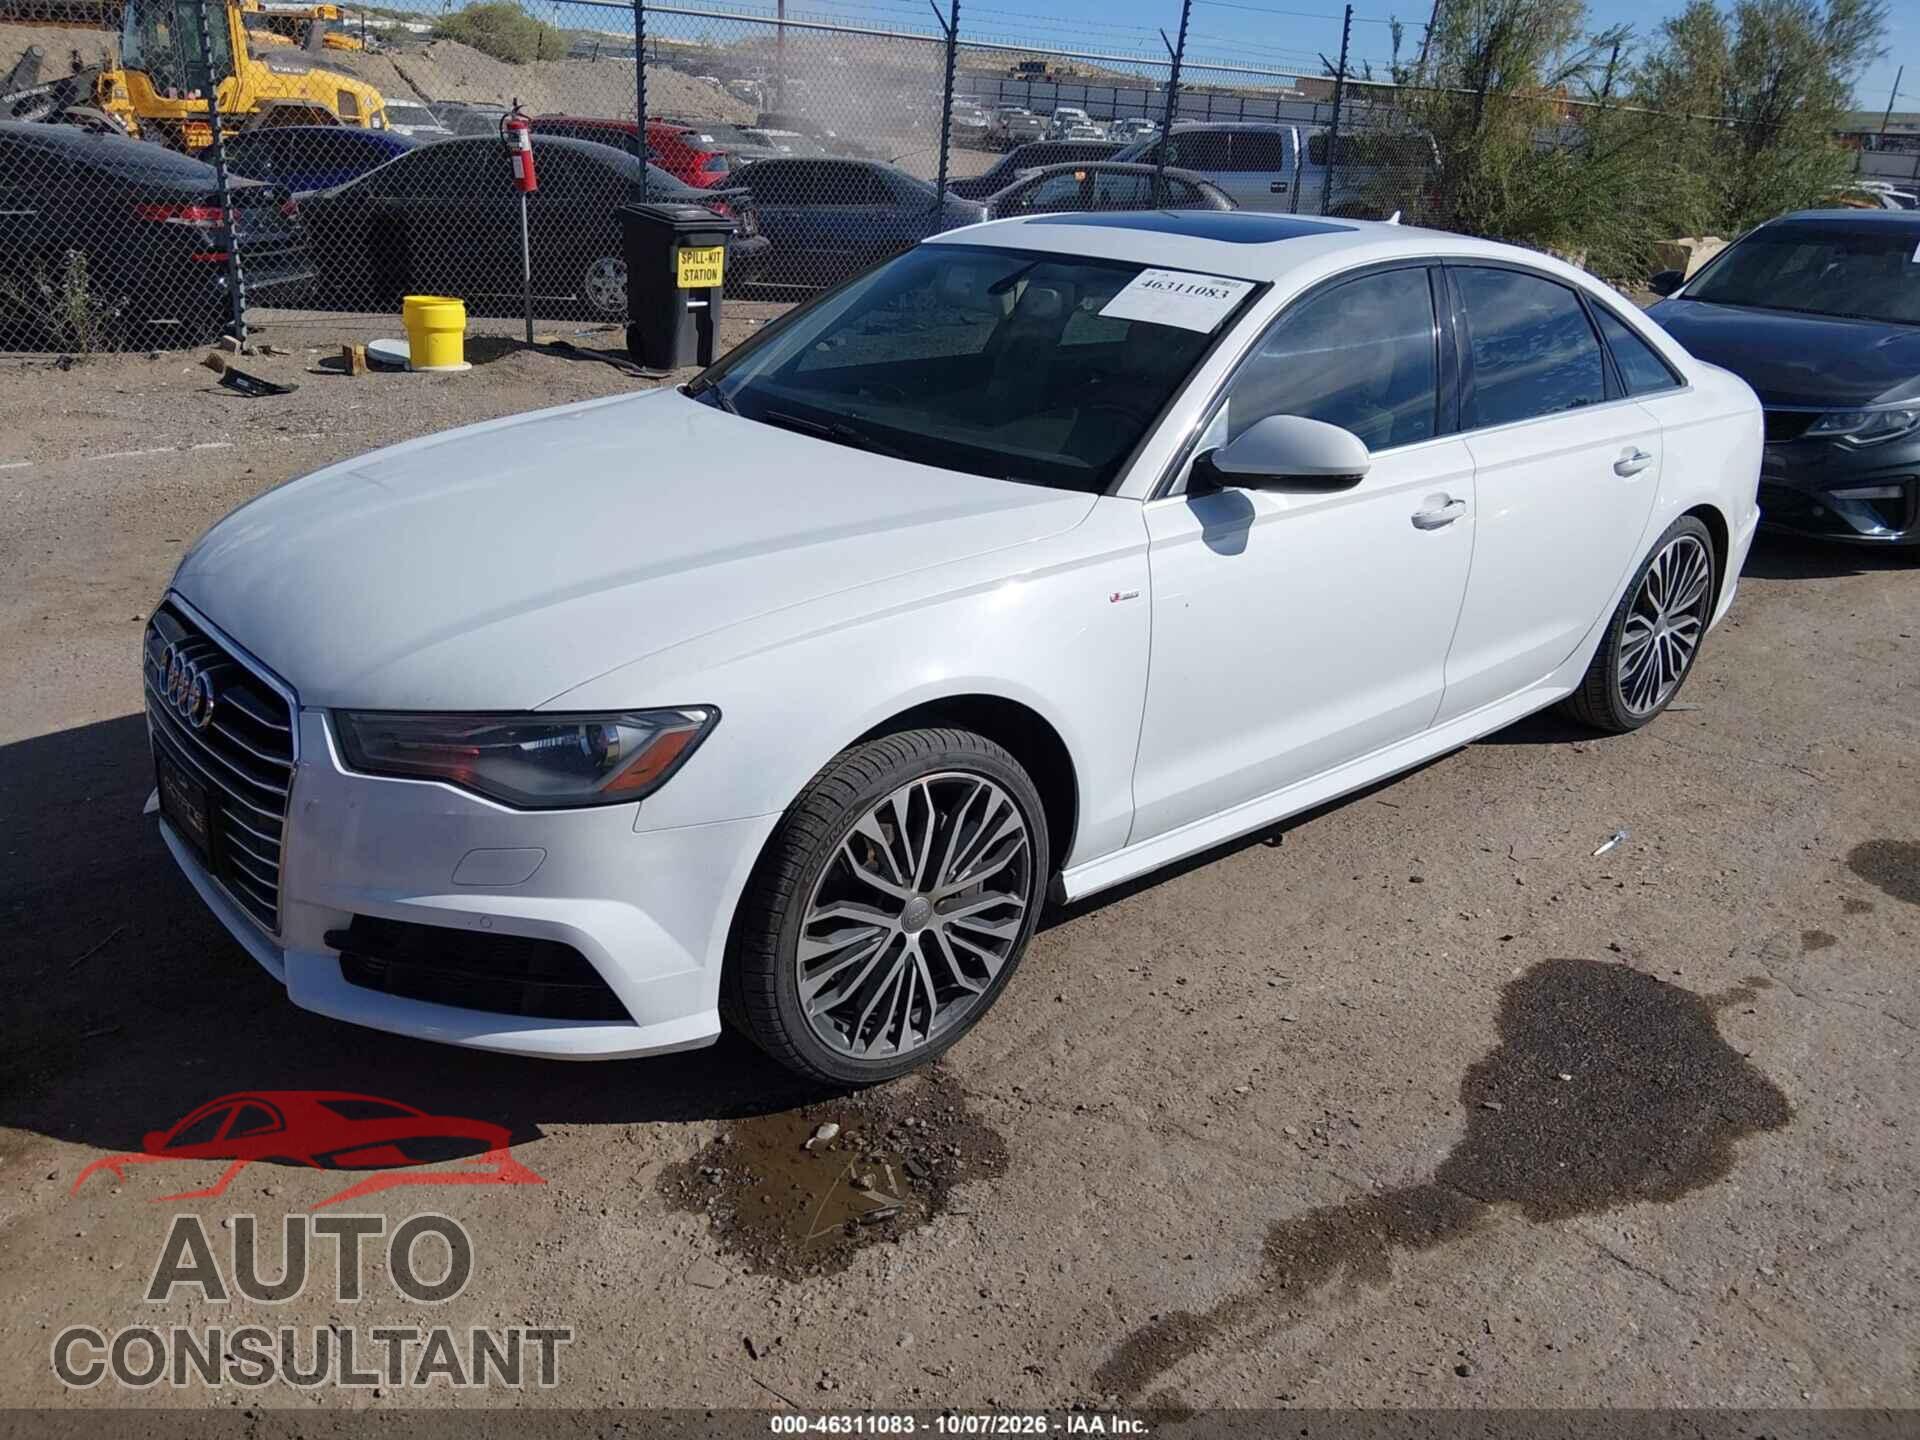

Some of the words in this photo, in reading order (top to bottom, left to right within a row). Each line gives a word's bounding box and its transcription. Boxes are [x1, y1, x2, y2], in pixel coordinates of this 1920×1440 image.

[681, 251, 721, 265] SPILL-KIT
[683, 268, 718, 281] STATION
[1141, 279, 1230, 300] 46311083
